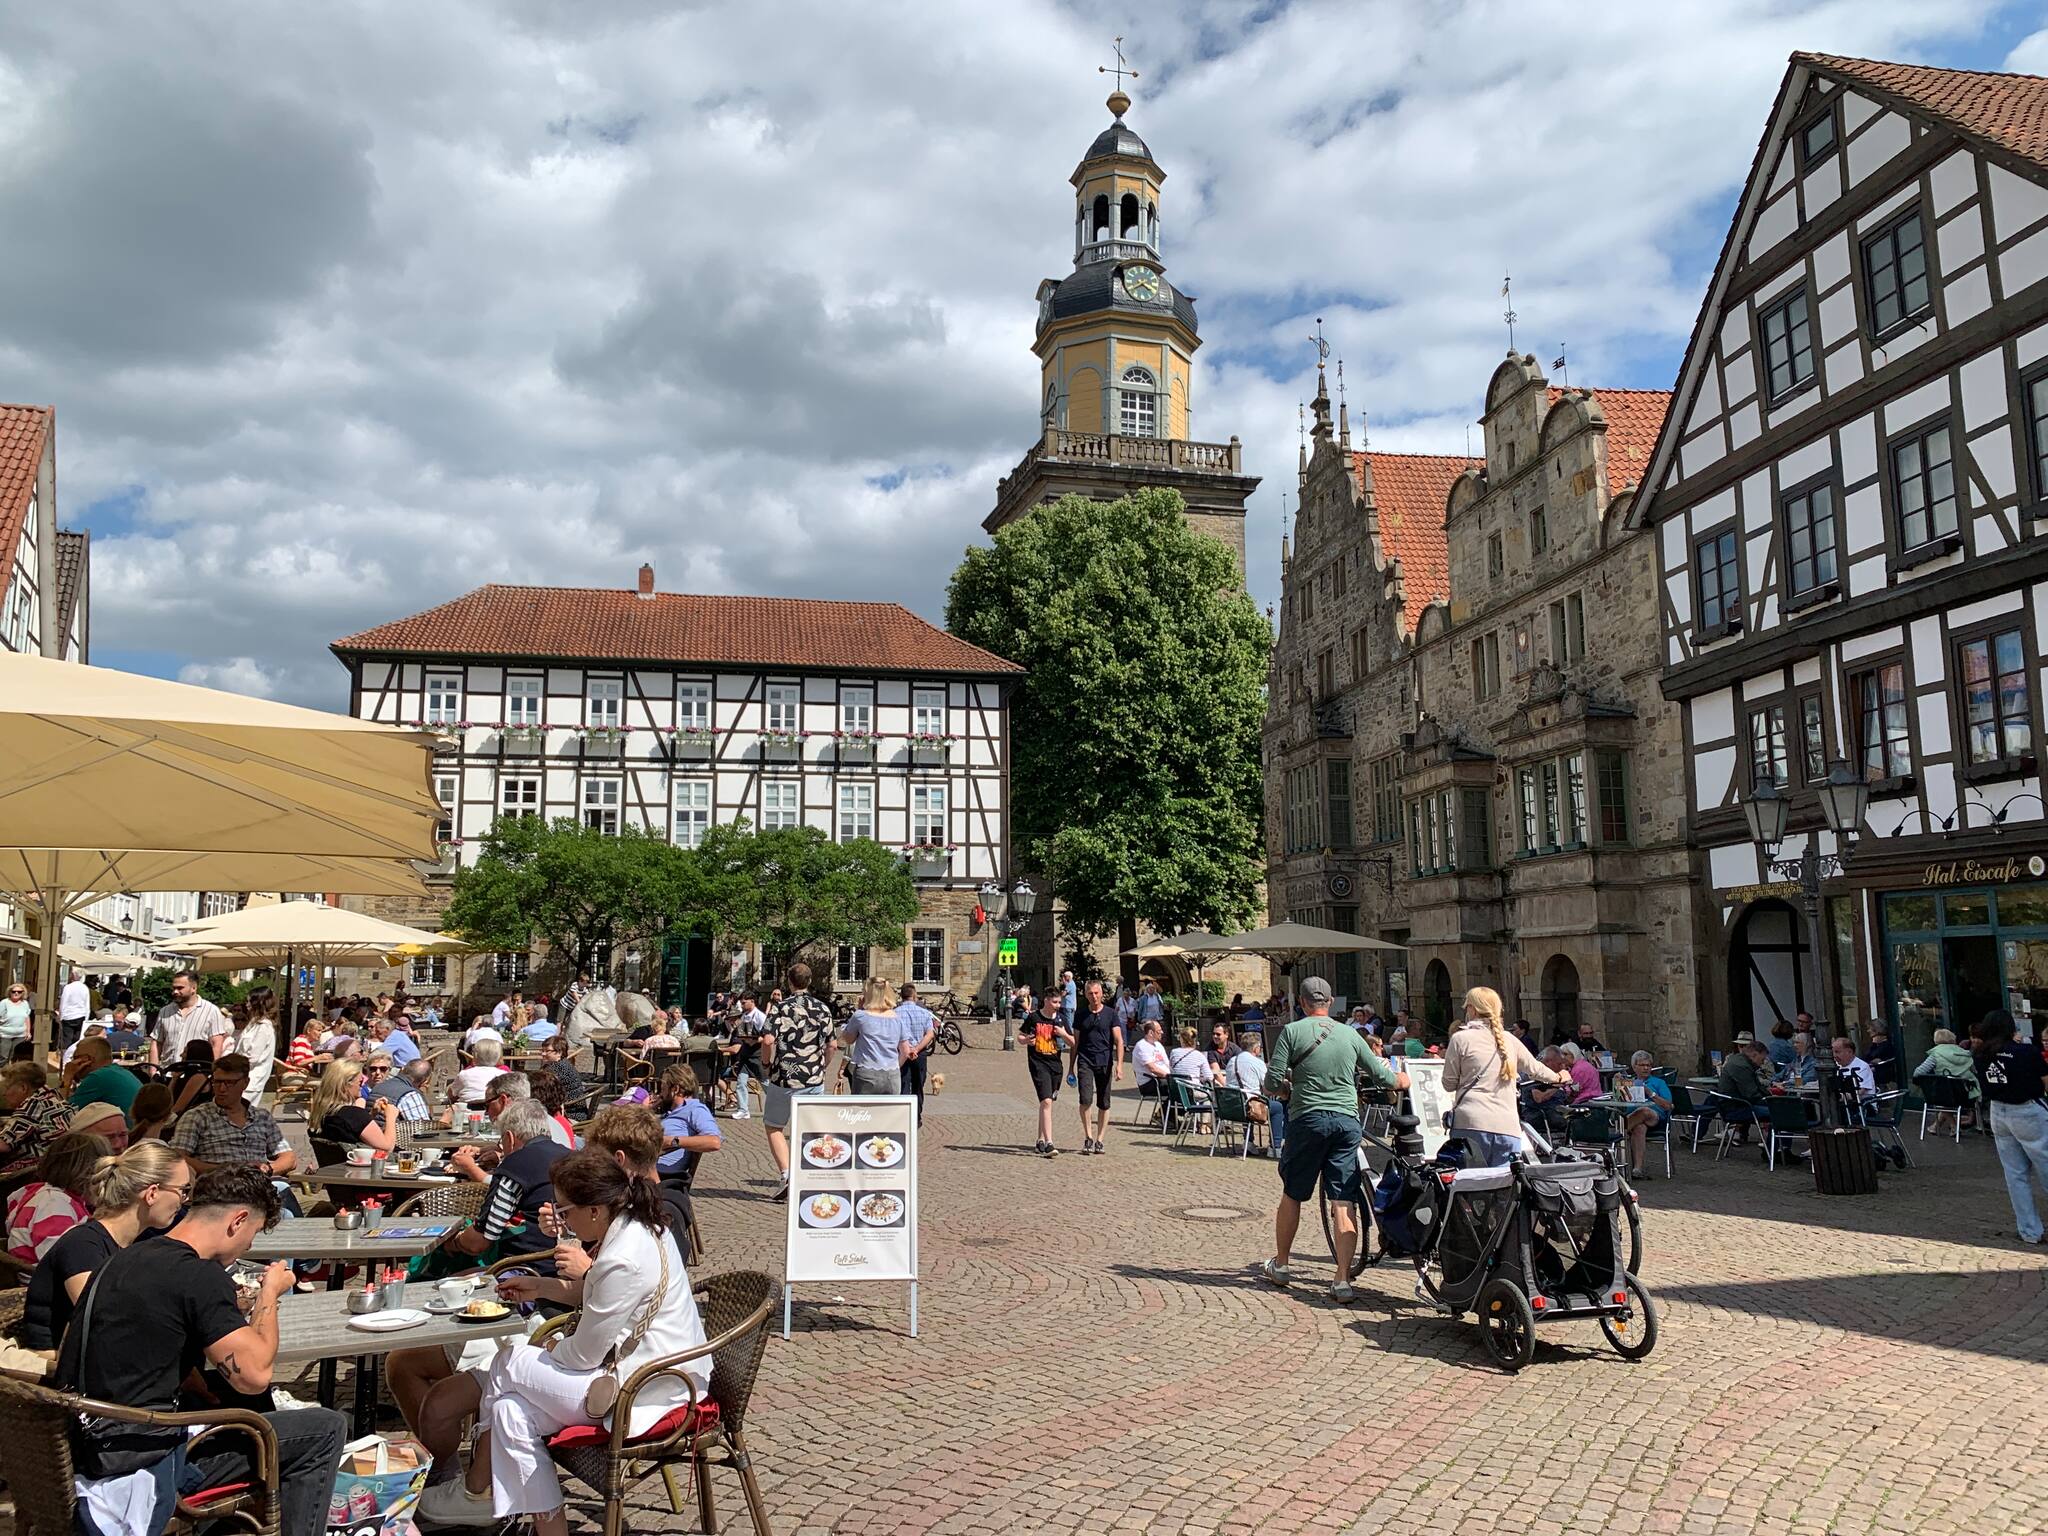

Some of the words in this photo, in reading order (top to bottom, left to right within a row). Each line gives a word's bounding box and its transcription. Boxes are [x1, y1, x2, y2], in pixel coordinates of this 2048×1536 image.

[1923, 862, 1960, 885] Ital.
[1963, 857, 2022, 883] Eiscafe
[839, 1109, 872, 1124] Waffeln
